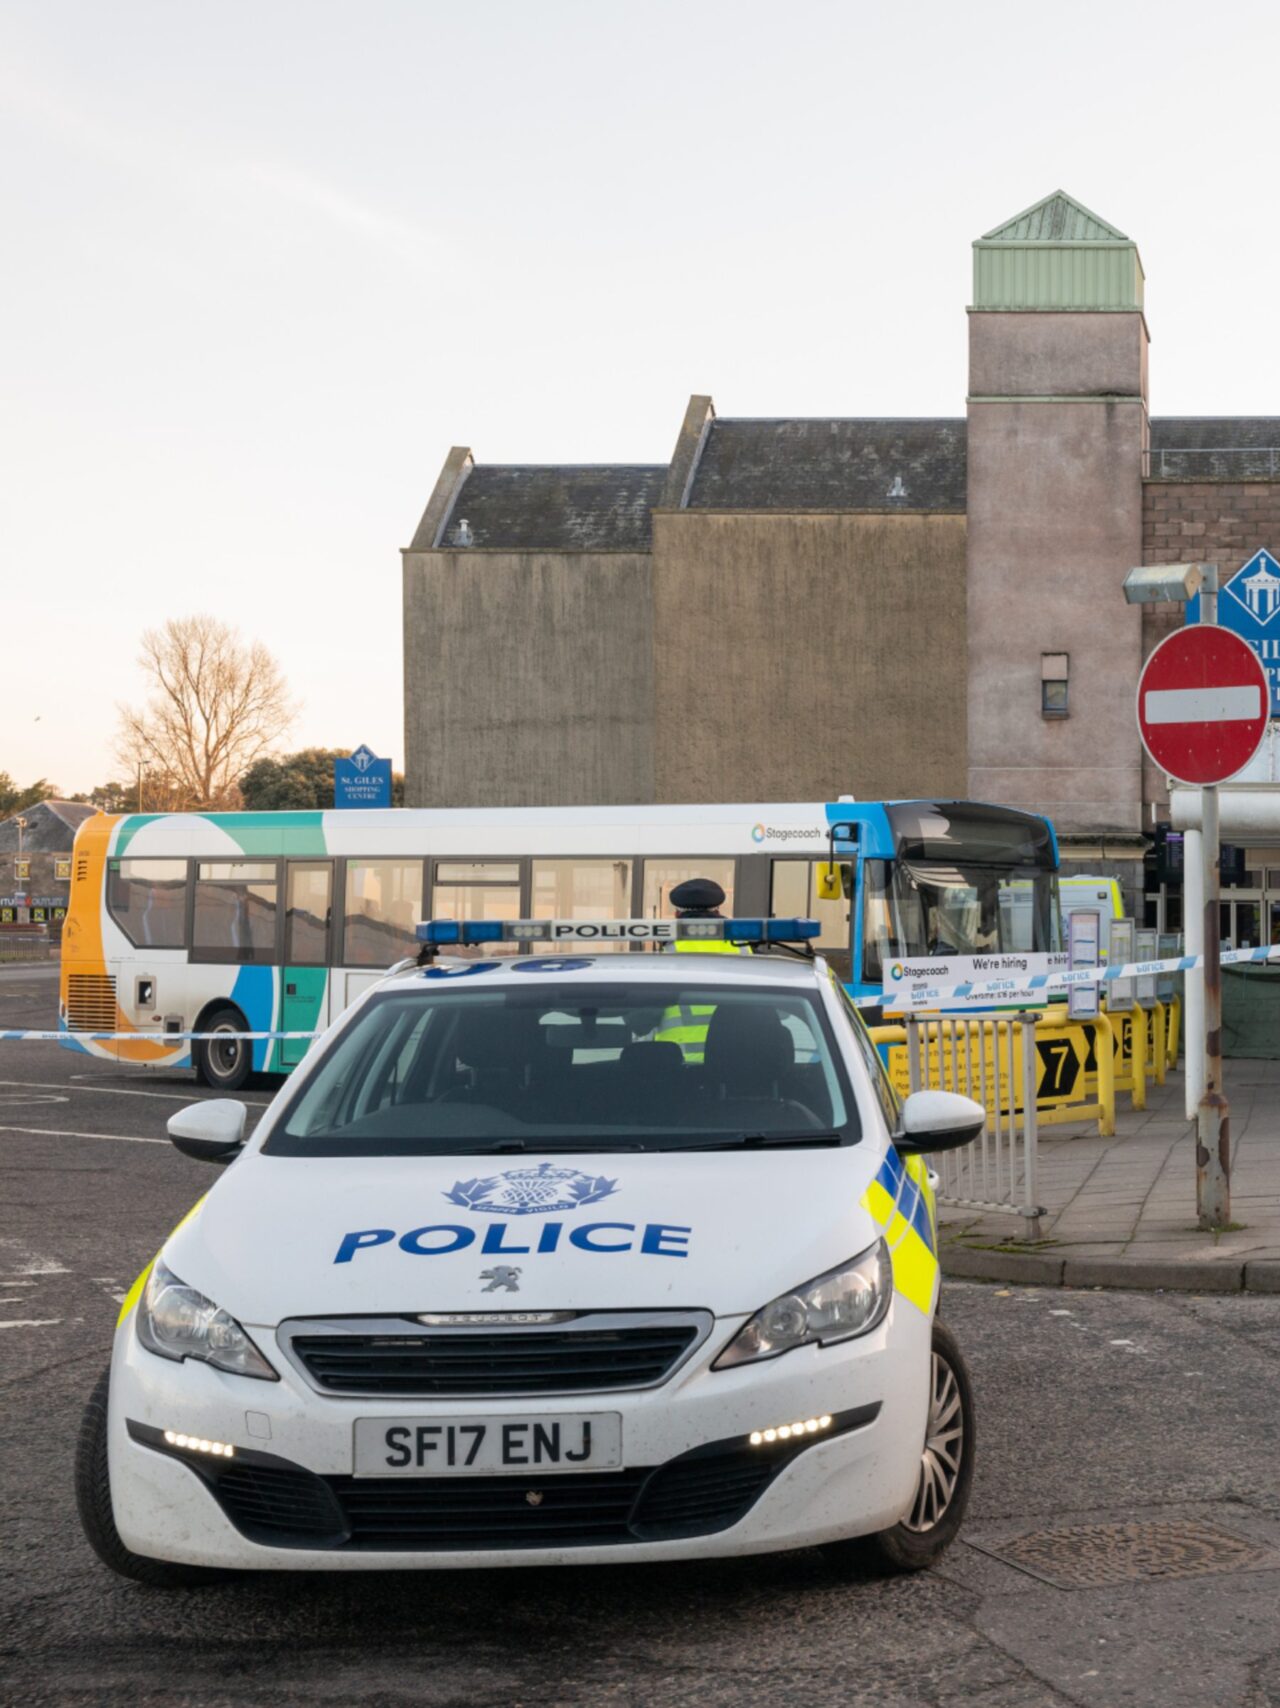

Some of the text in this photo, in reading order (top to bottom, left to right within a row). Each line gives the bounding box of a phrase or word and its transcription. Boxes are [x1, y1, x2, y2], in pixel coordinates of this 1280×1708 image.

[766, 827, 821, 841] Stagecoach
[555, 924, 671, 938] POLICE
[972, 956, 1028, 971] We're hiring
[903, 965, 949, 979] Stagecoach
[1050, 1045, 1069, 1089] 7
[333, 1222, 692, 1265] POLICE
[449, 1313, 542, 1323] PEUGEOT
[385, 1421, 592, 1468] SF17 ENJ
